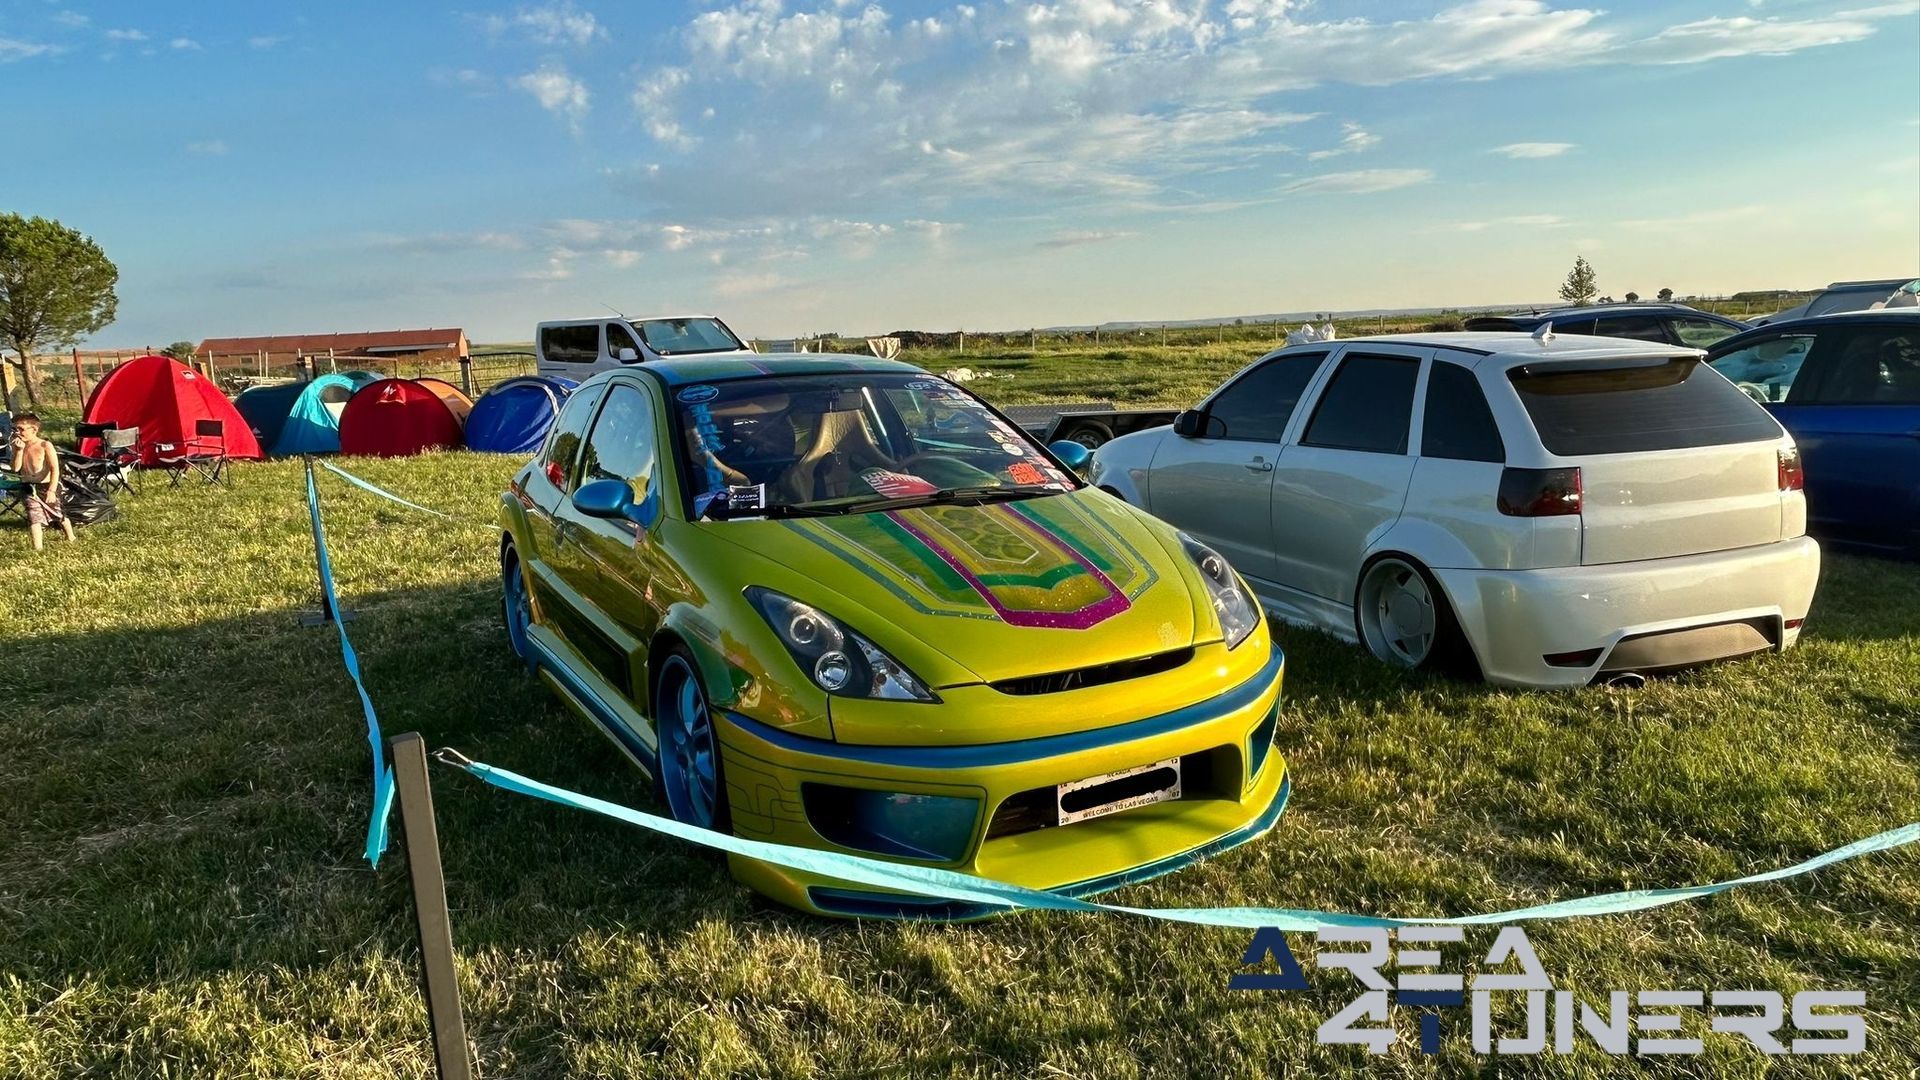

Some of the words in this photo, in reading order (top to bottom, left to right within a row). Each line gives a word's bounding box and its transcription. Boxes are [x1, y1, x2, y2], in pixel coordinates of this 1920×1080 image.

[1083, 806, 1114, 818] WELCOME
[1124, 801, 1137, 809] LAS
[1138, 796, 1159, 805] VEGAS
